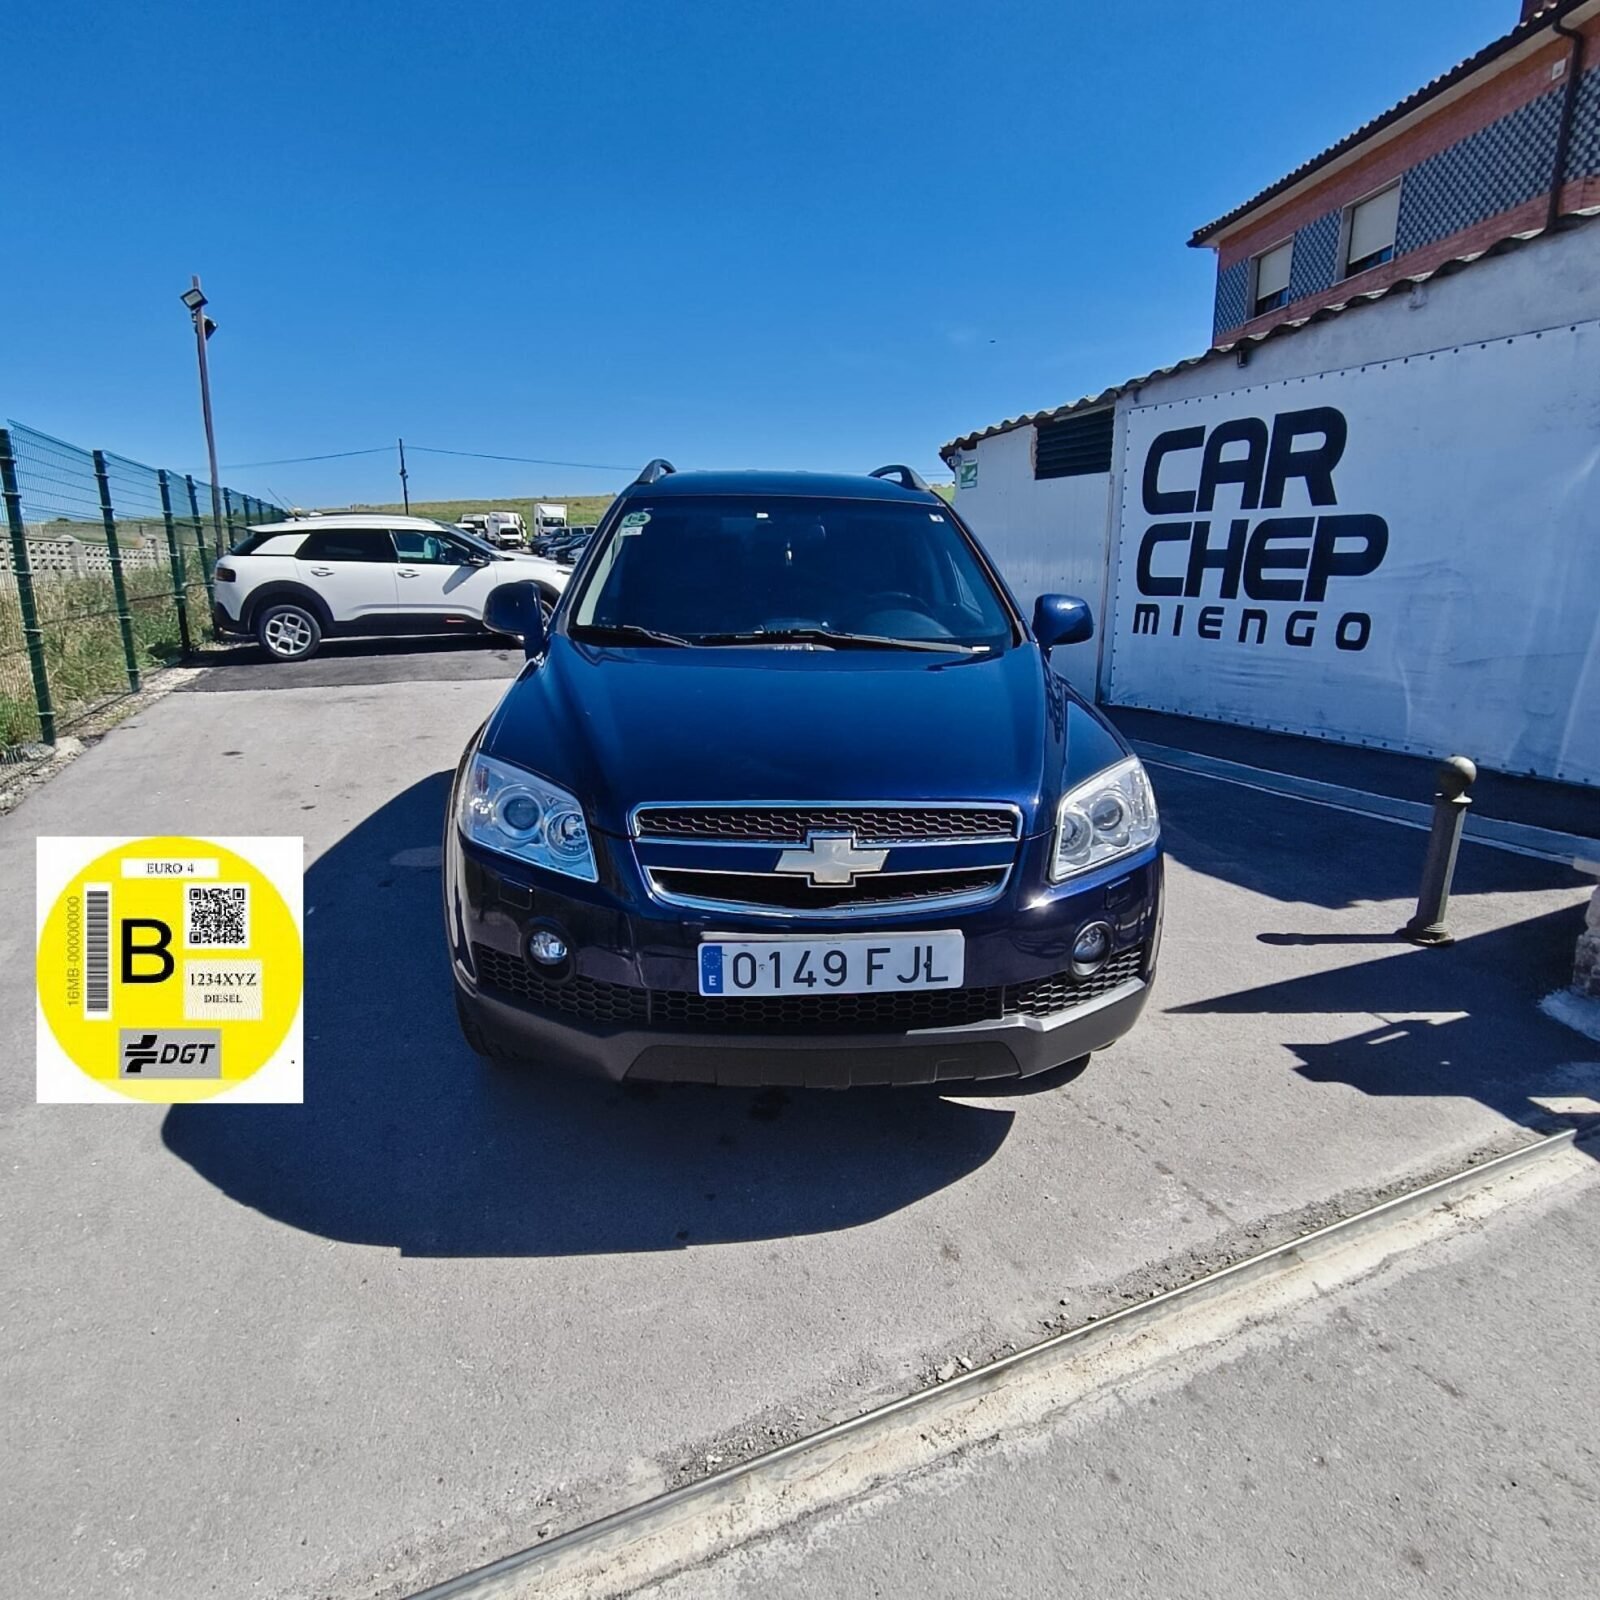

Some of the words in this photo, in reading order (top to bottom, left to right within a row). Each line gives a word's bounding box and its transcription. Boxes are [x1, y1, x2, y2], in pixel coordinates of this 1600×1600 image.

[1142, 406, 1347, 515] CAR
[1136, 513, 1389, 602] CHEP
[1132, 603, 1371, 651] MIENGO
[708, 975, 717, 986] E
[732, 950, 847, 989] 0149
[866, 945, 949, 986] FJL
